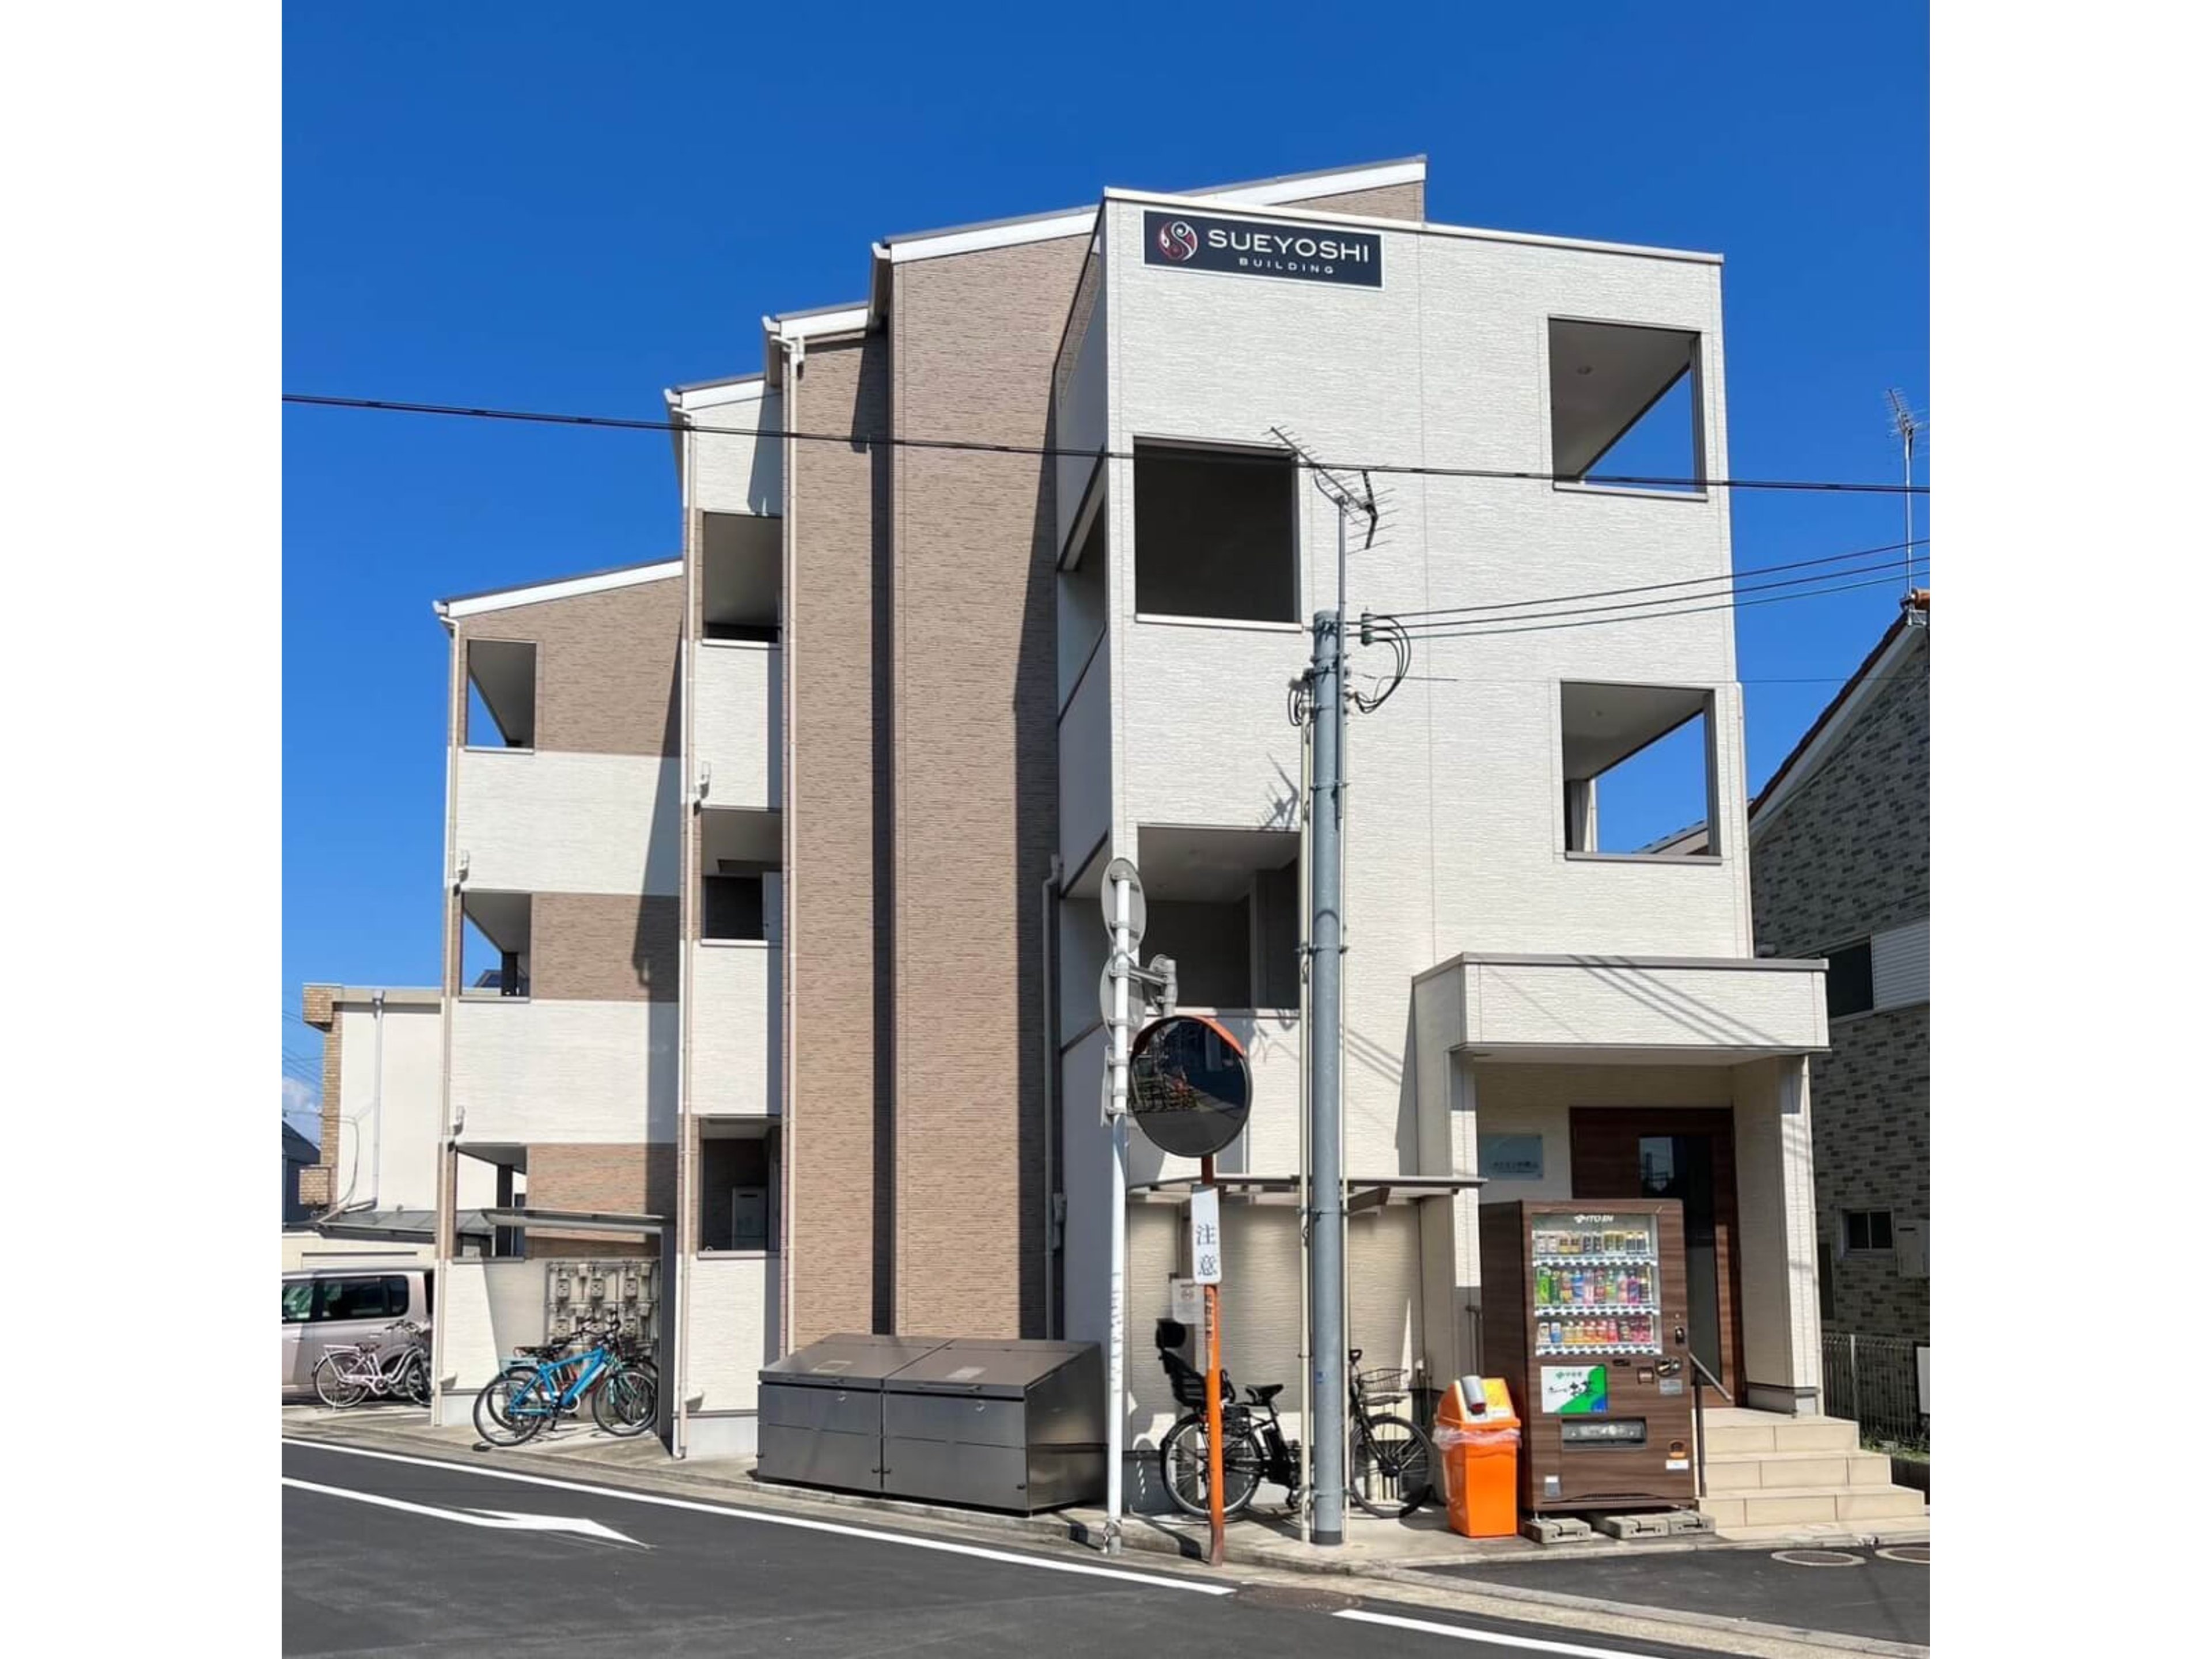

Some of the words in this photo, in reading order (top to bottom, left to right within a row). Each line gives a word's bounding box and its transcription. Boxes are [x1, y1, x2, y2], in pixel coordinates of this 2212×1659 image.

[1208, 229, 1369, 262] SUEYOSHI
[1239, 257, 1334, 274] BUILDING
[1196, 1224, 1218, 1276] 注意
